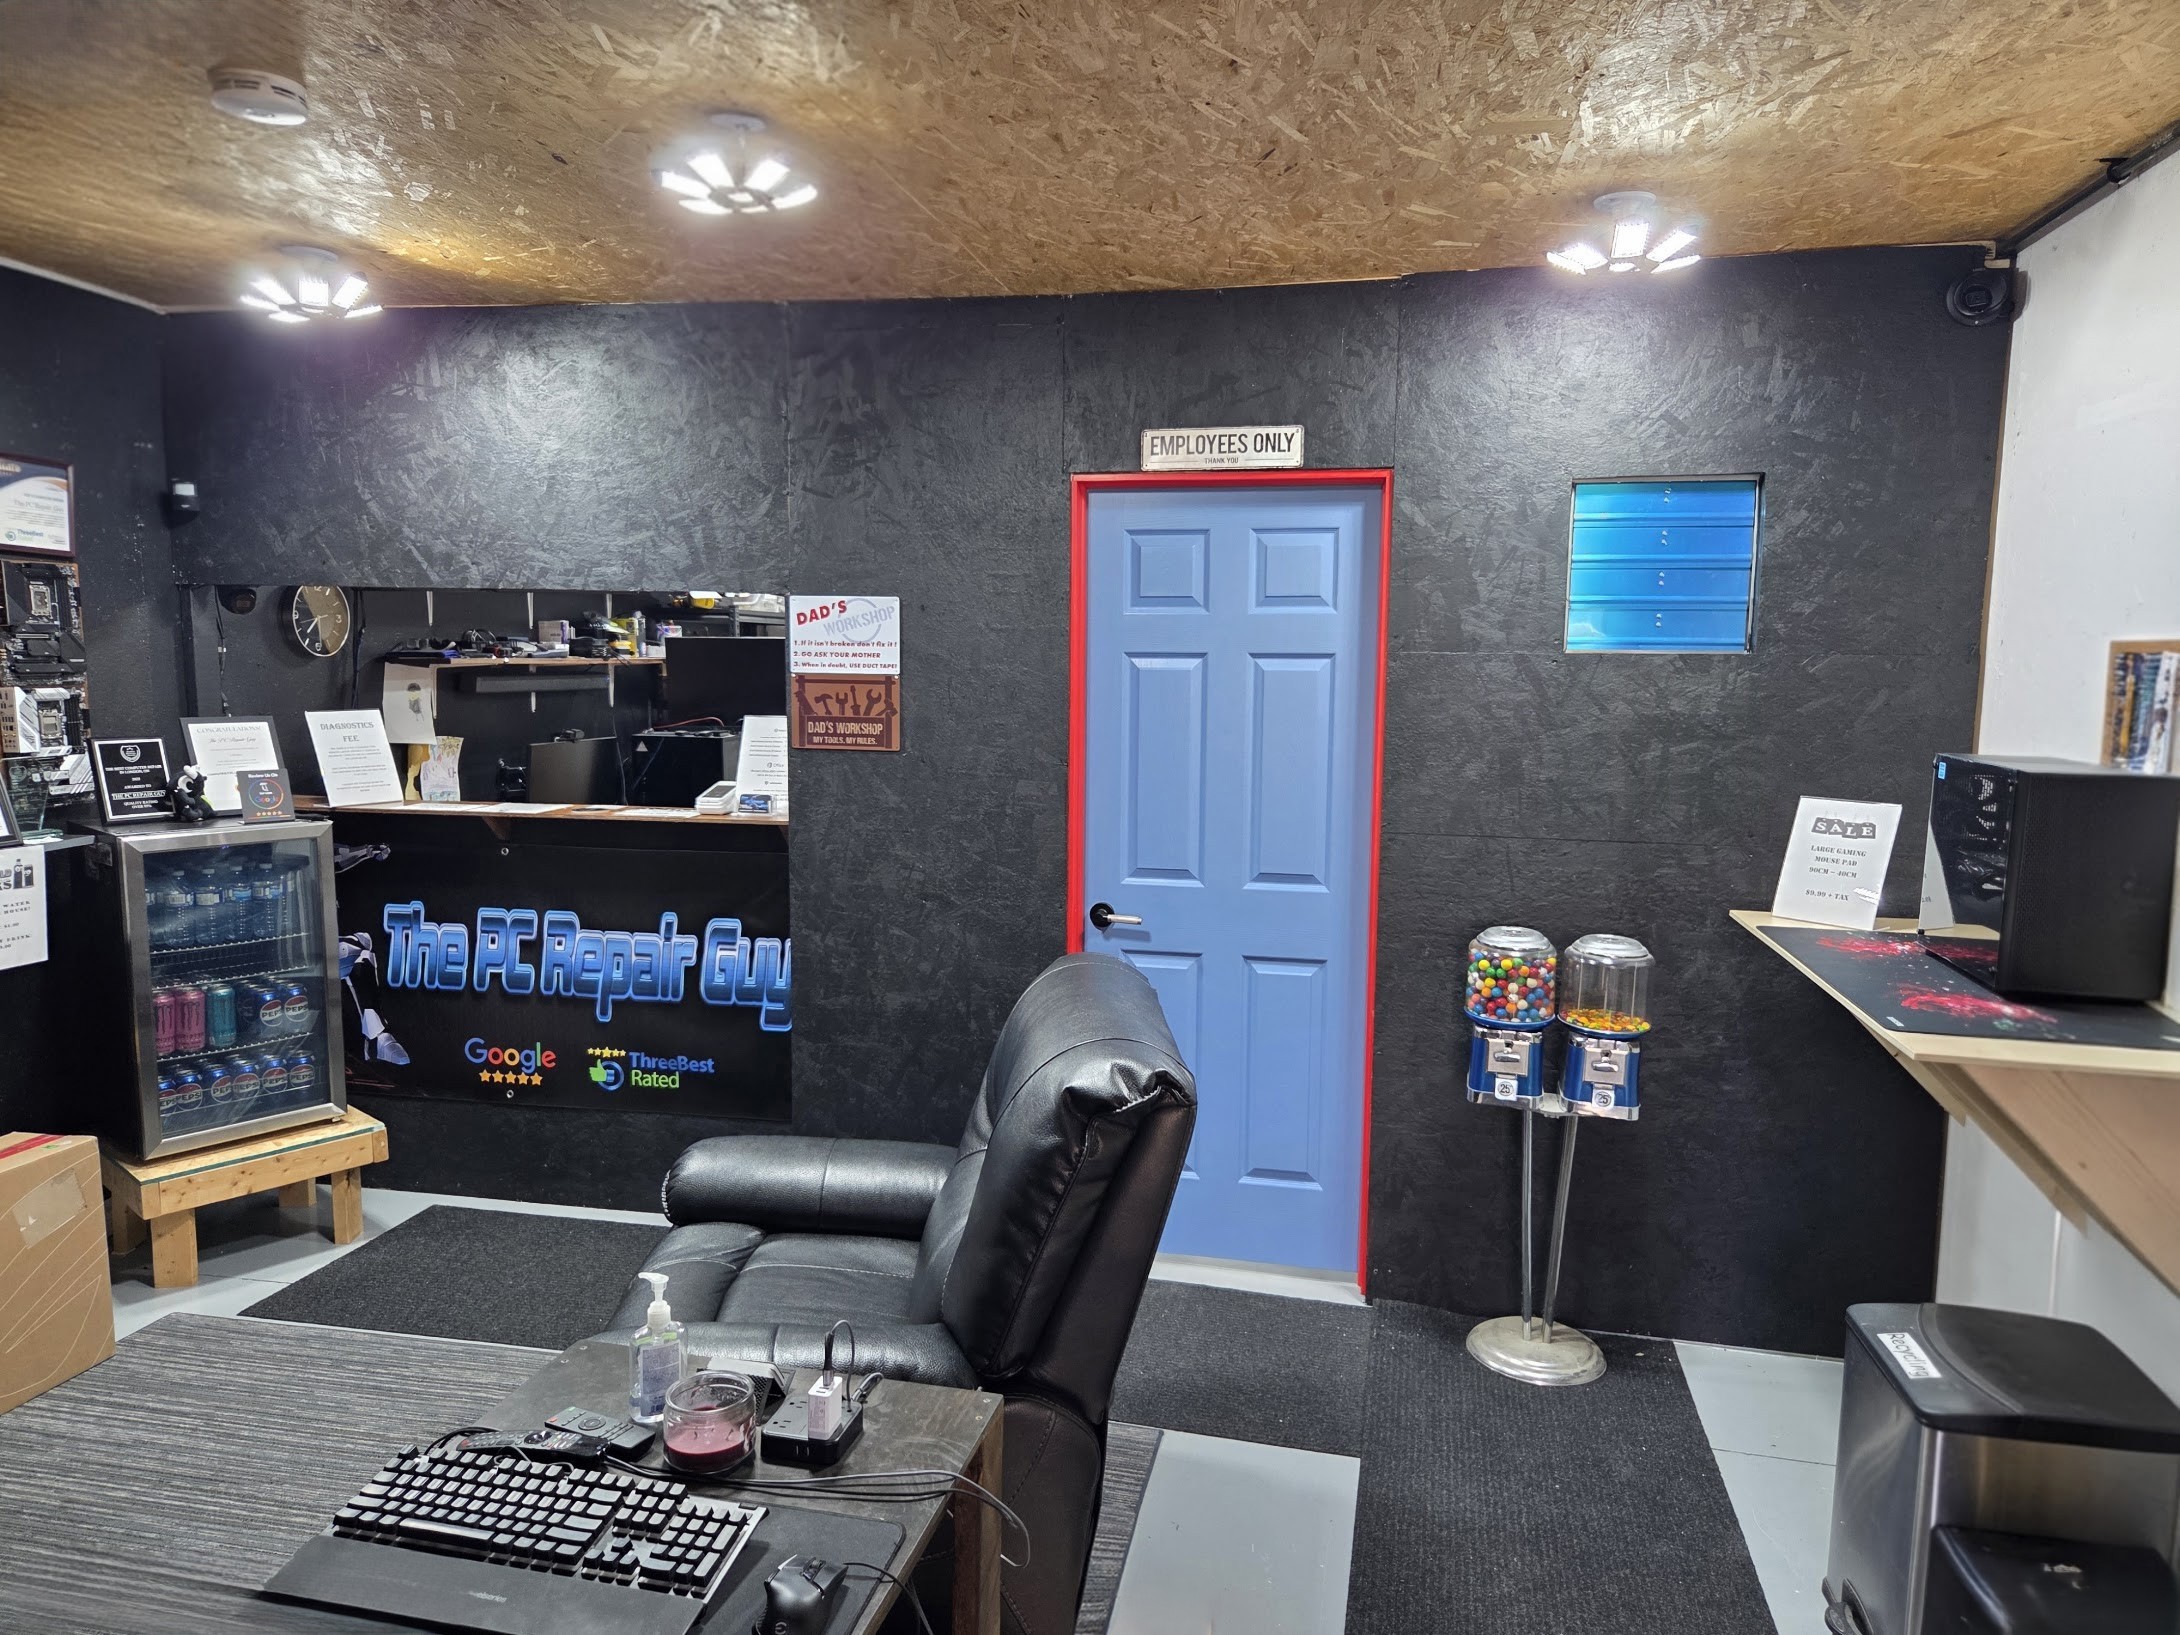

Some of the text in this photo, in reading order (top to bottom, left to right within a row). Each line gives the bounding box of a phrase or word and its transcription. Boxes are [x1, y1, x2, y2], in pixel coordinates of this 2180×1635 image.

[1150, 432, 1295, 456] EMPLOYEES ONLY
[336, 614, 342, 623] 3
[796, 600, 895, 637] DAD'S WORKSHOP
[320, 722, 374, 730] DIAGNOSTICS
[808, 721, 883, 735] DAD'S WORKSHOP
[255, 795, 281, 804] Google
[1815, 822, 1874, 836] SALE
[1811, 845, 1867, 857] LARGE GAMING
[1815, 856, 1840, 865] MOUSE
[1809, 867, 1829, 875] 90CM
[383, 900, 792, 1032] The PC Repair Guy
[464, 1037, 557, 1074] Google
[629, 1052, 715, 1074] ThreeBest
[631, 1070, 680, 1088] Rated
[213, 1086, 233, 1094] PEP
[1887, 1334, 1929, 1376] Recycling
